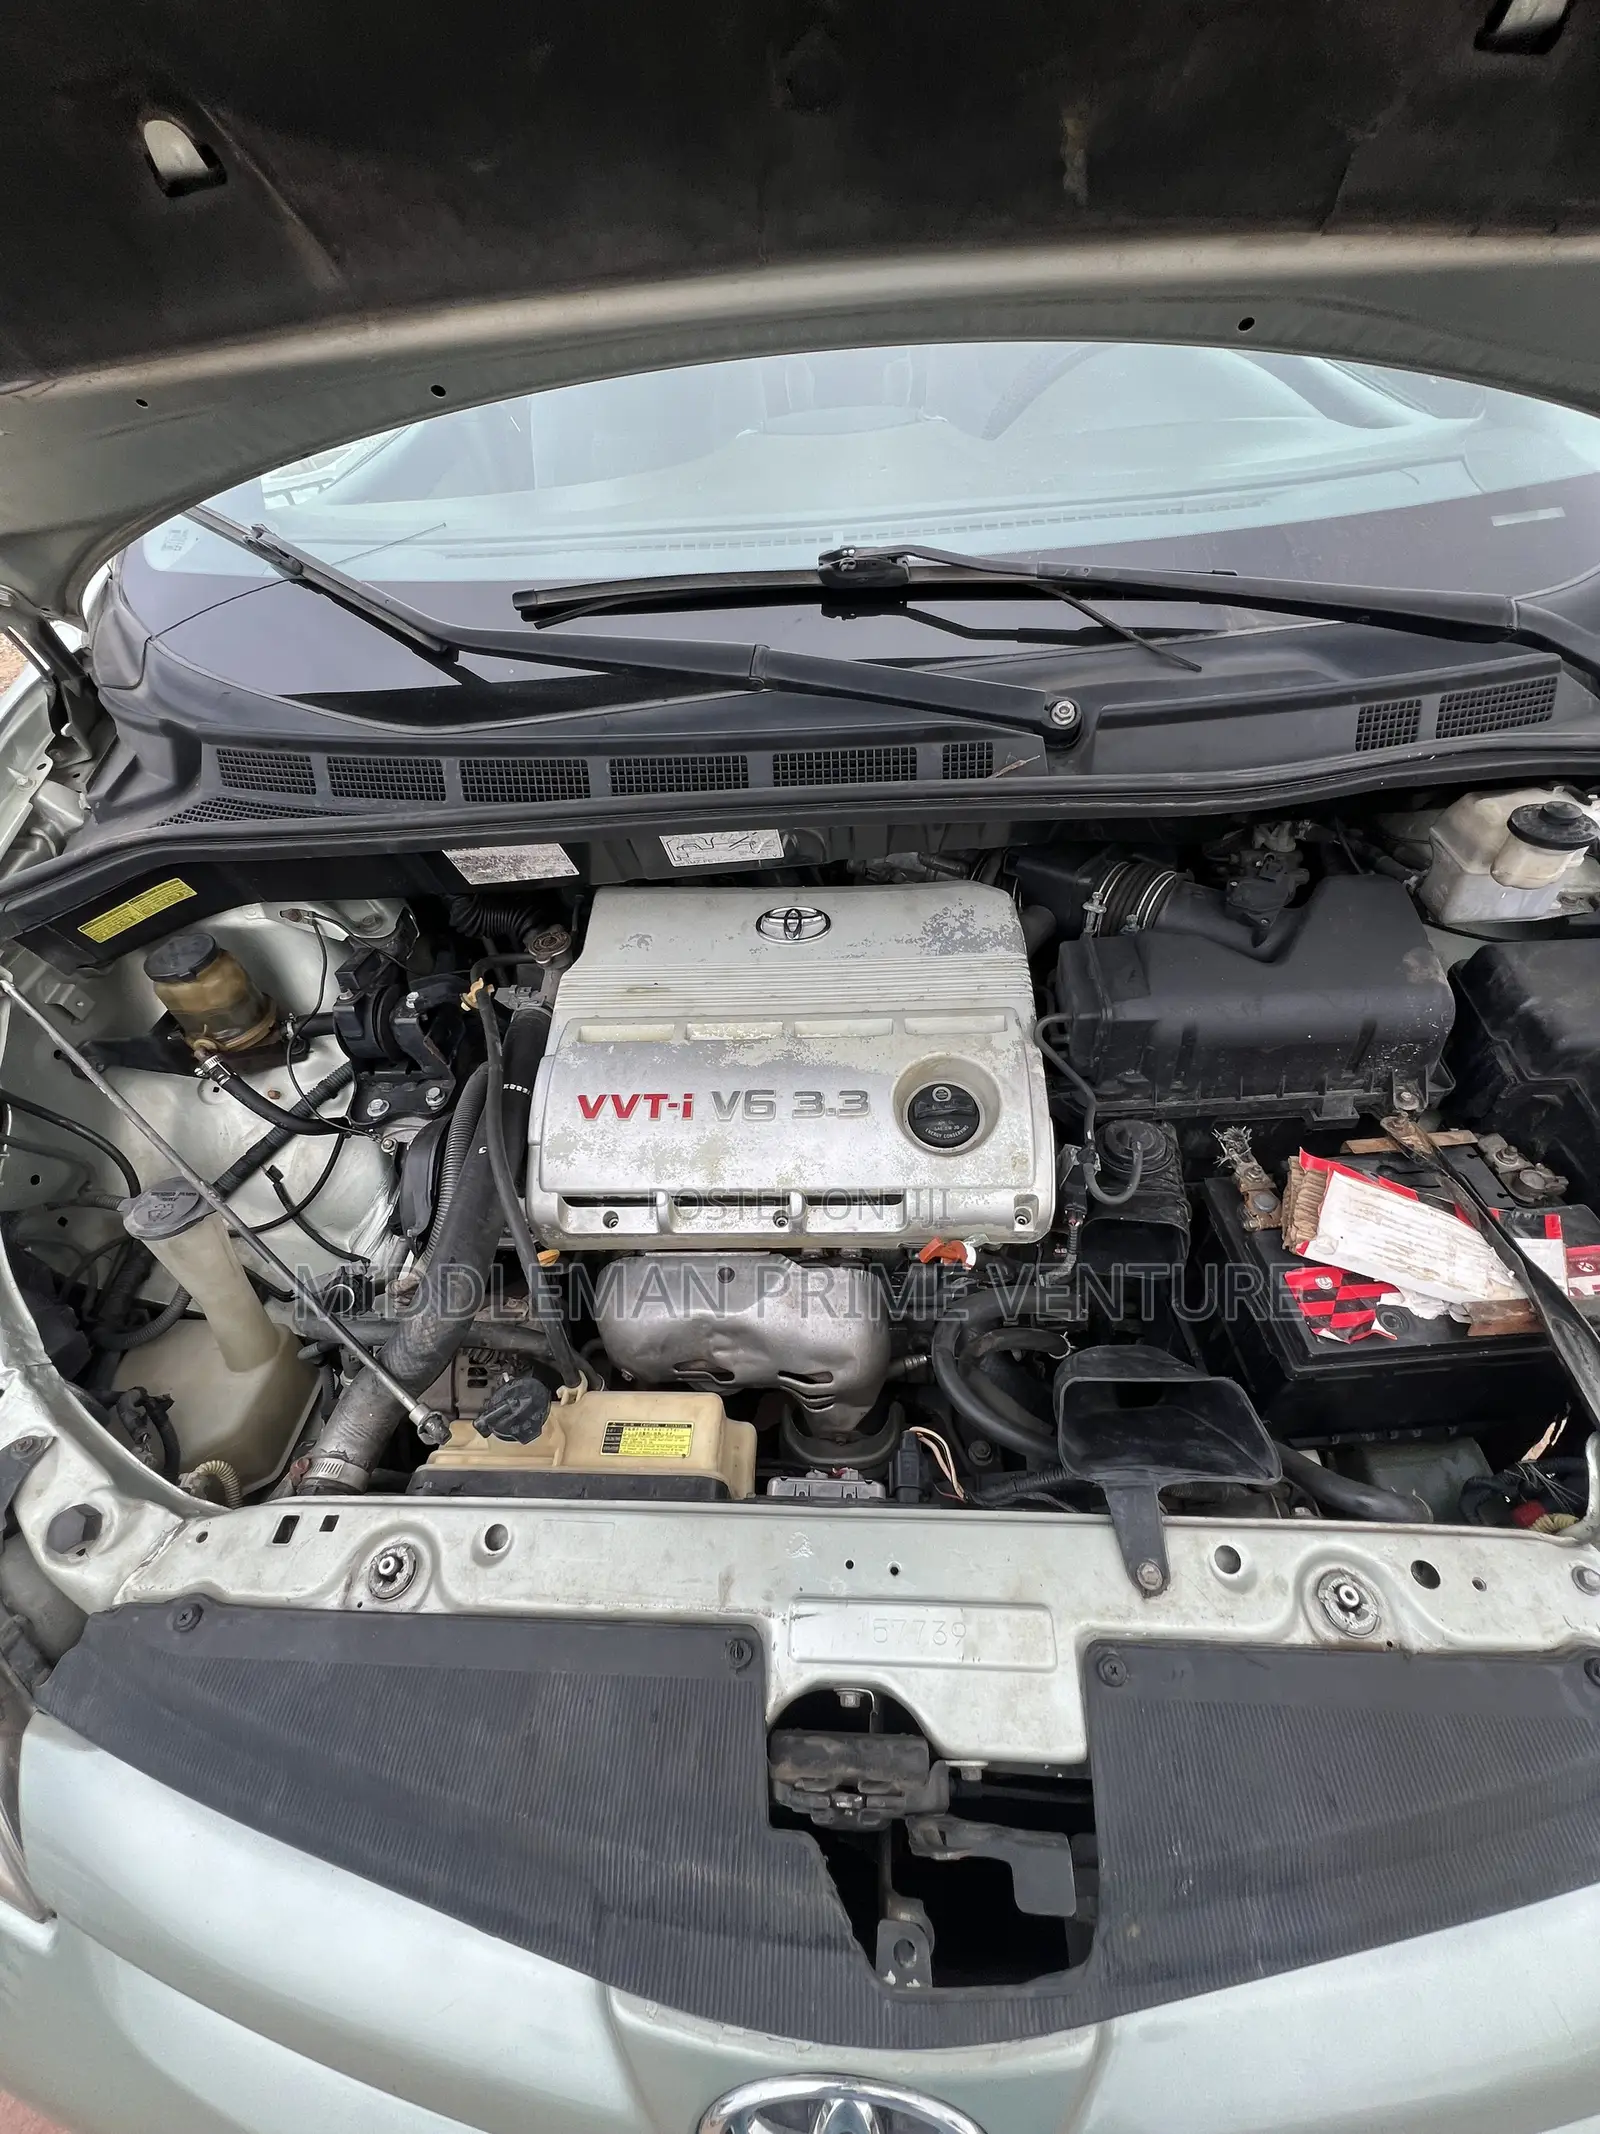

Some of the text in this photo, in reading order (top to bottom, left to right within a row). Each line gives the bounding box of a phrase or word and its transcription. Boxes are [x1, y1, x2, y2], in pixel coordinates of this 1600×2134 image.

[577, 1090, 869, 1121] VVT-i V6 3.3
[925, 1127, 942, 1138] ENERGY
